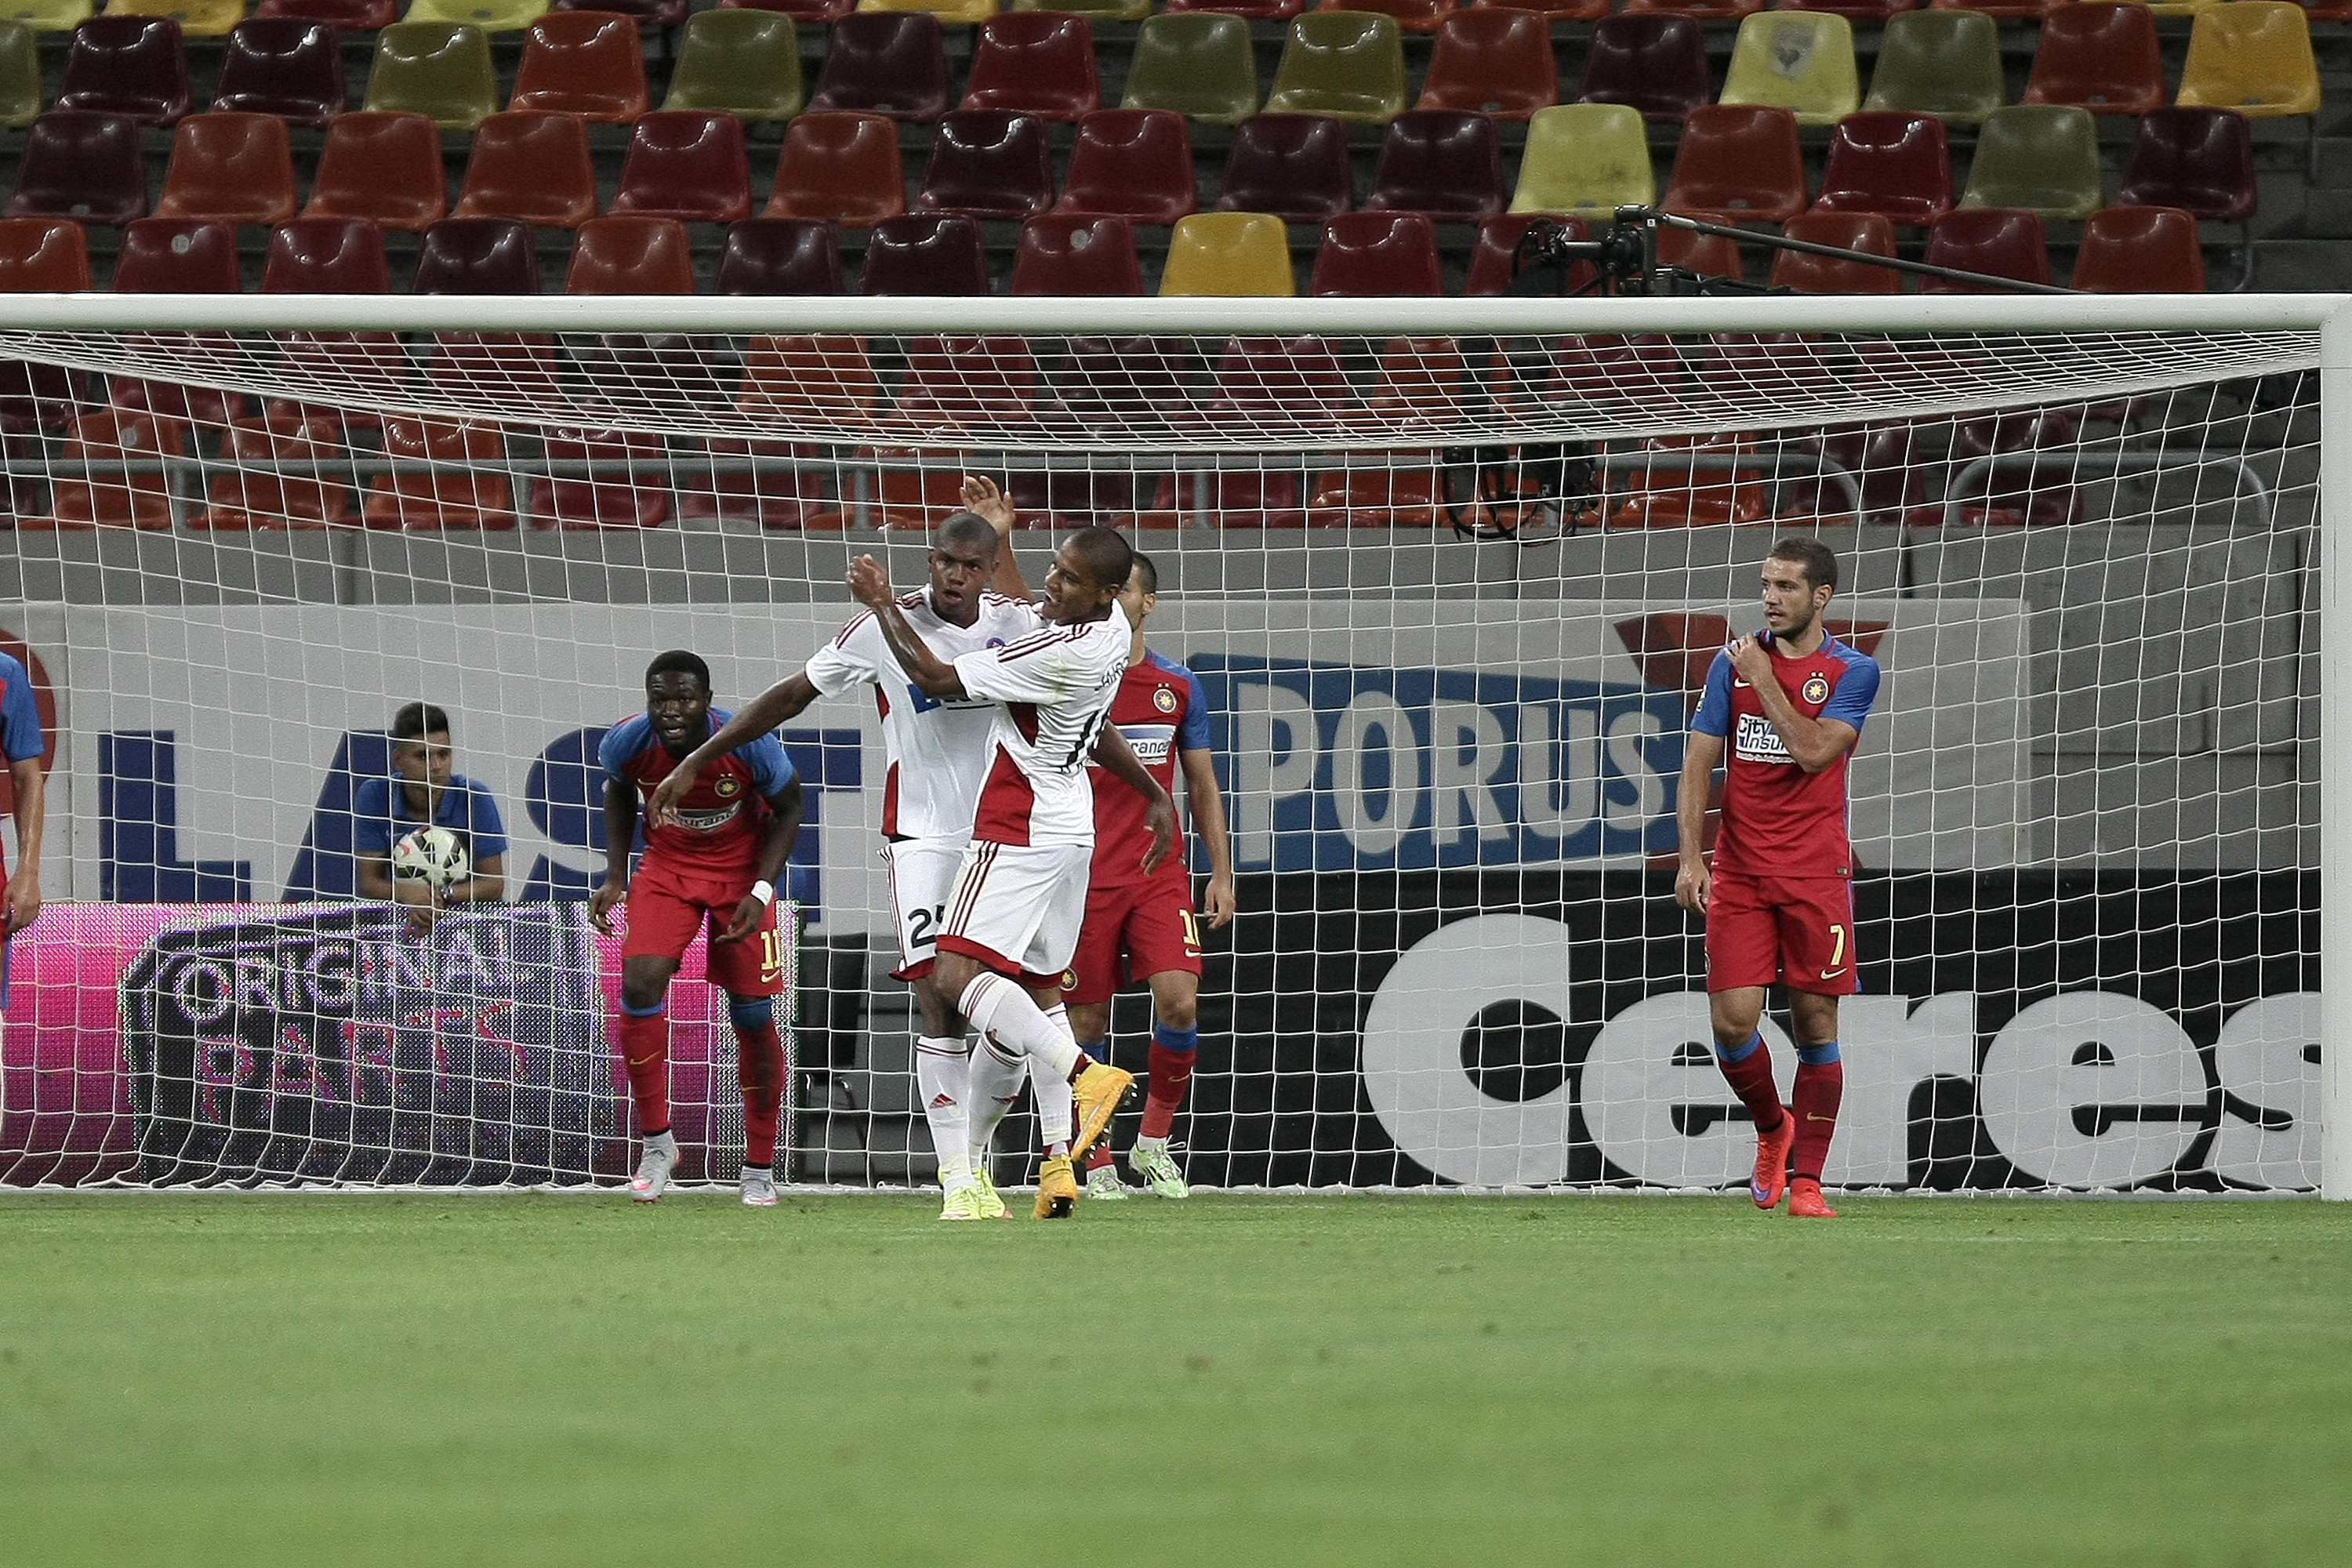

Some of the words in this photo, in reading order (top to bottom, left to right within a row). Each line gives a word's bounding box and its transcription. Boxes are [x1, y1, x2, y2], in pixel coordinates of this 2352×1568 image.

[1237, 682, 1664, 862] PORUS
[1739, 717, 1771, 735] City
[172, 922, 533, 1024] ORIGINAL
[1830, 924, 1845, 966] 7
[198, 1000, 528, 1123] PARTS
[1363, 913, 2321, 1187] Ceres
